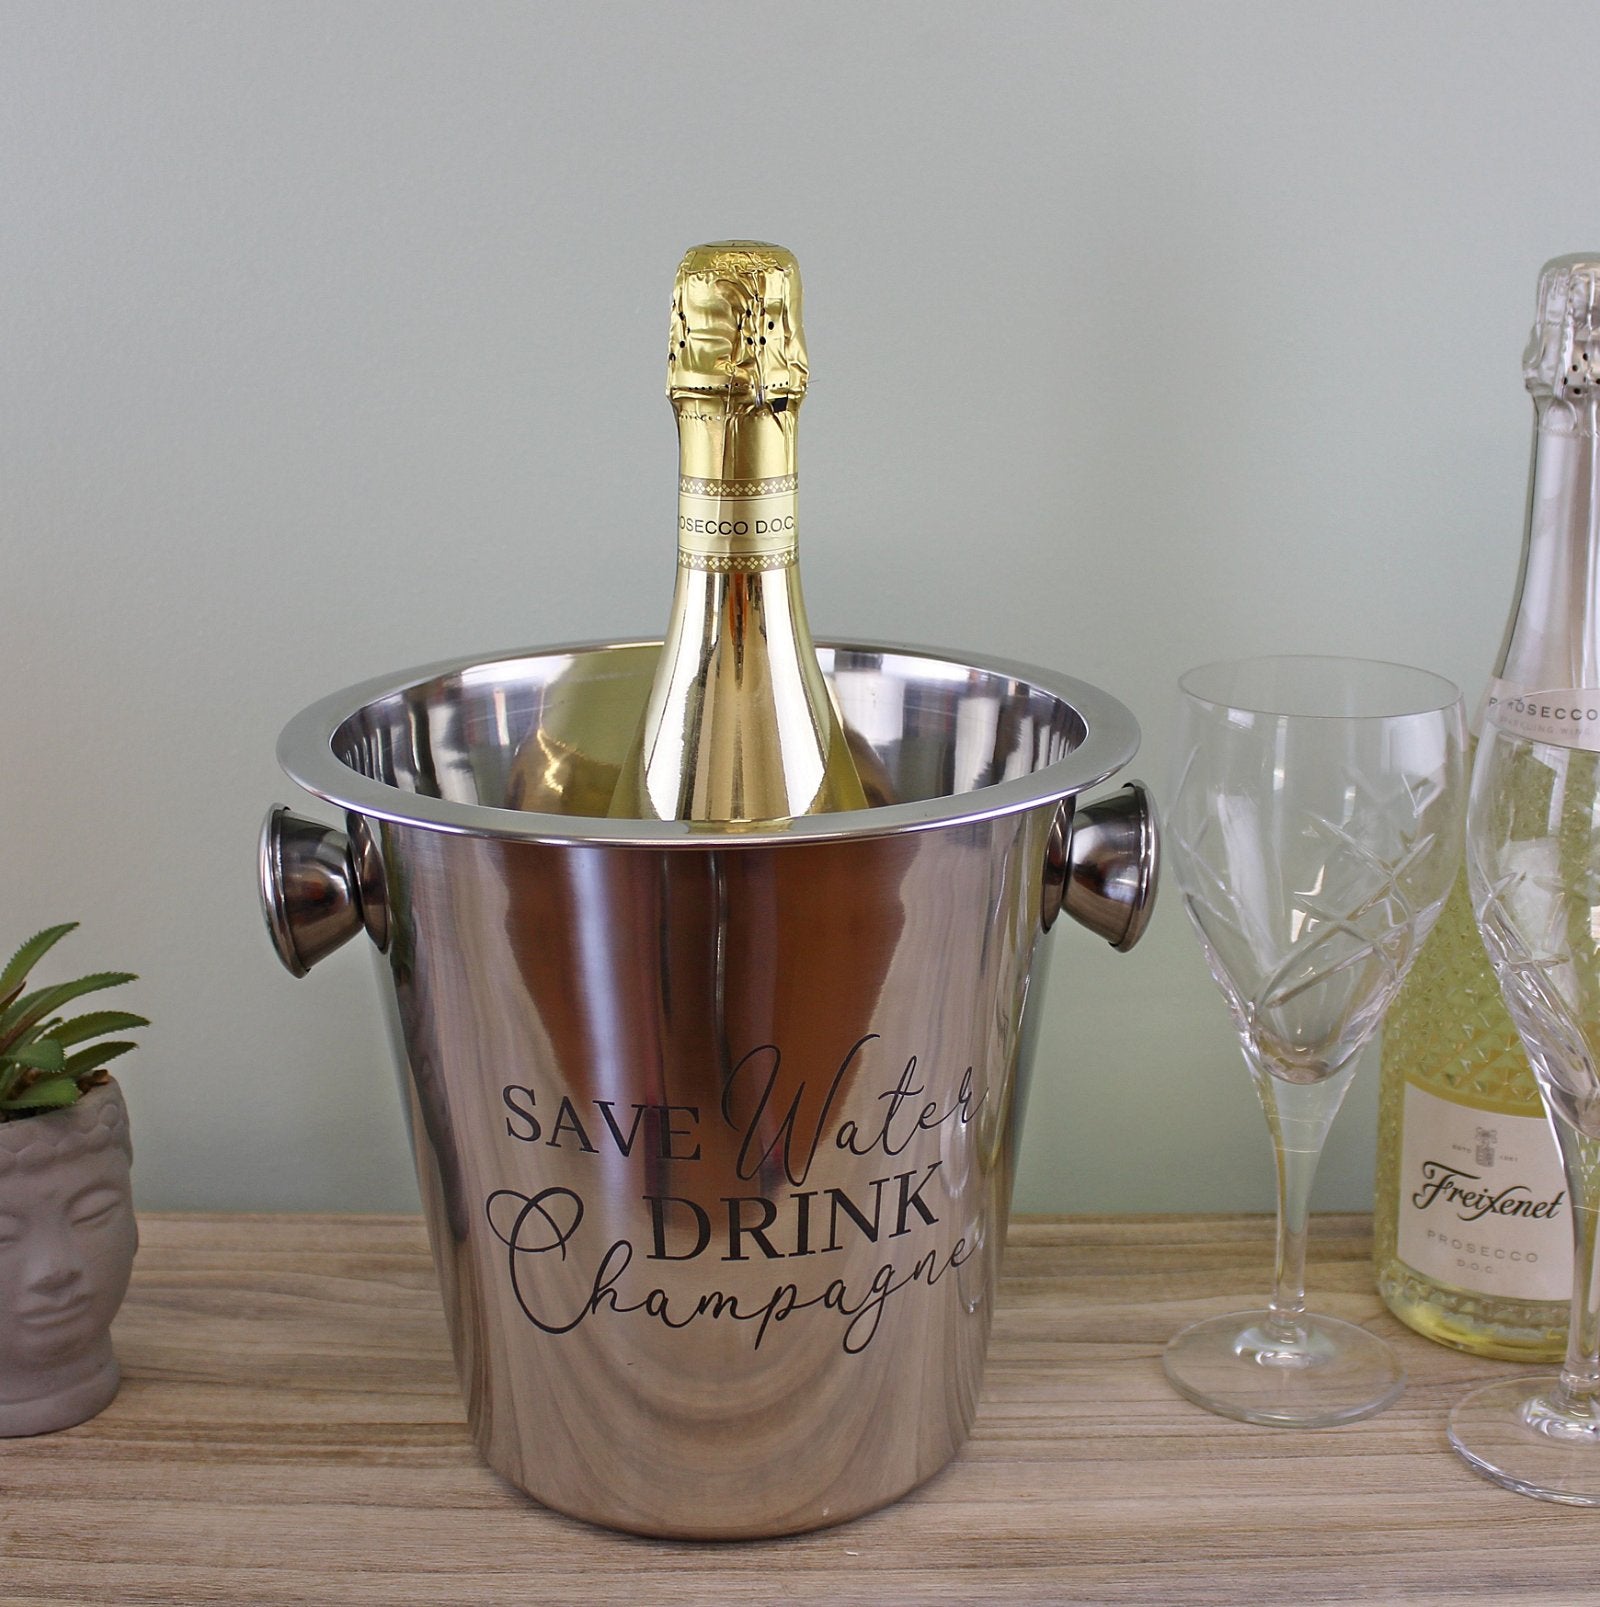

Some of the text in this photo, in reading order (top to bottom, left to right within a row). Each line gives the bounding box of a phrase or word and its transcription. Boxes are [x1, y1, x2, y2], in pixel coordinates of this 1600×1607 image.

[501, 1033, 990, 1188] SAVE Water
[642, 1160, 943, 1263] DRINK
[1412, 1160, 1567, 1222] Freixenet
[485, 1185, 979, 1355] Champagne
[1426, 1229, 1539, 1264] PROSECCO
